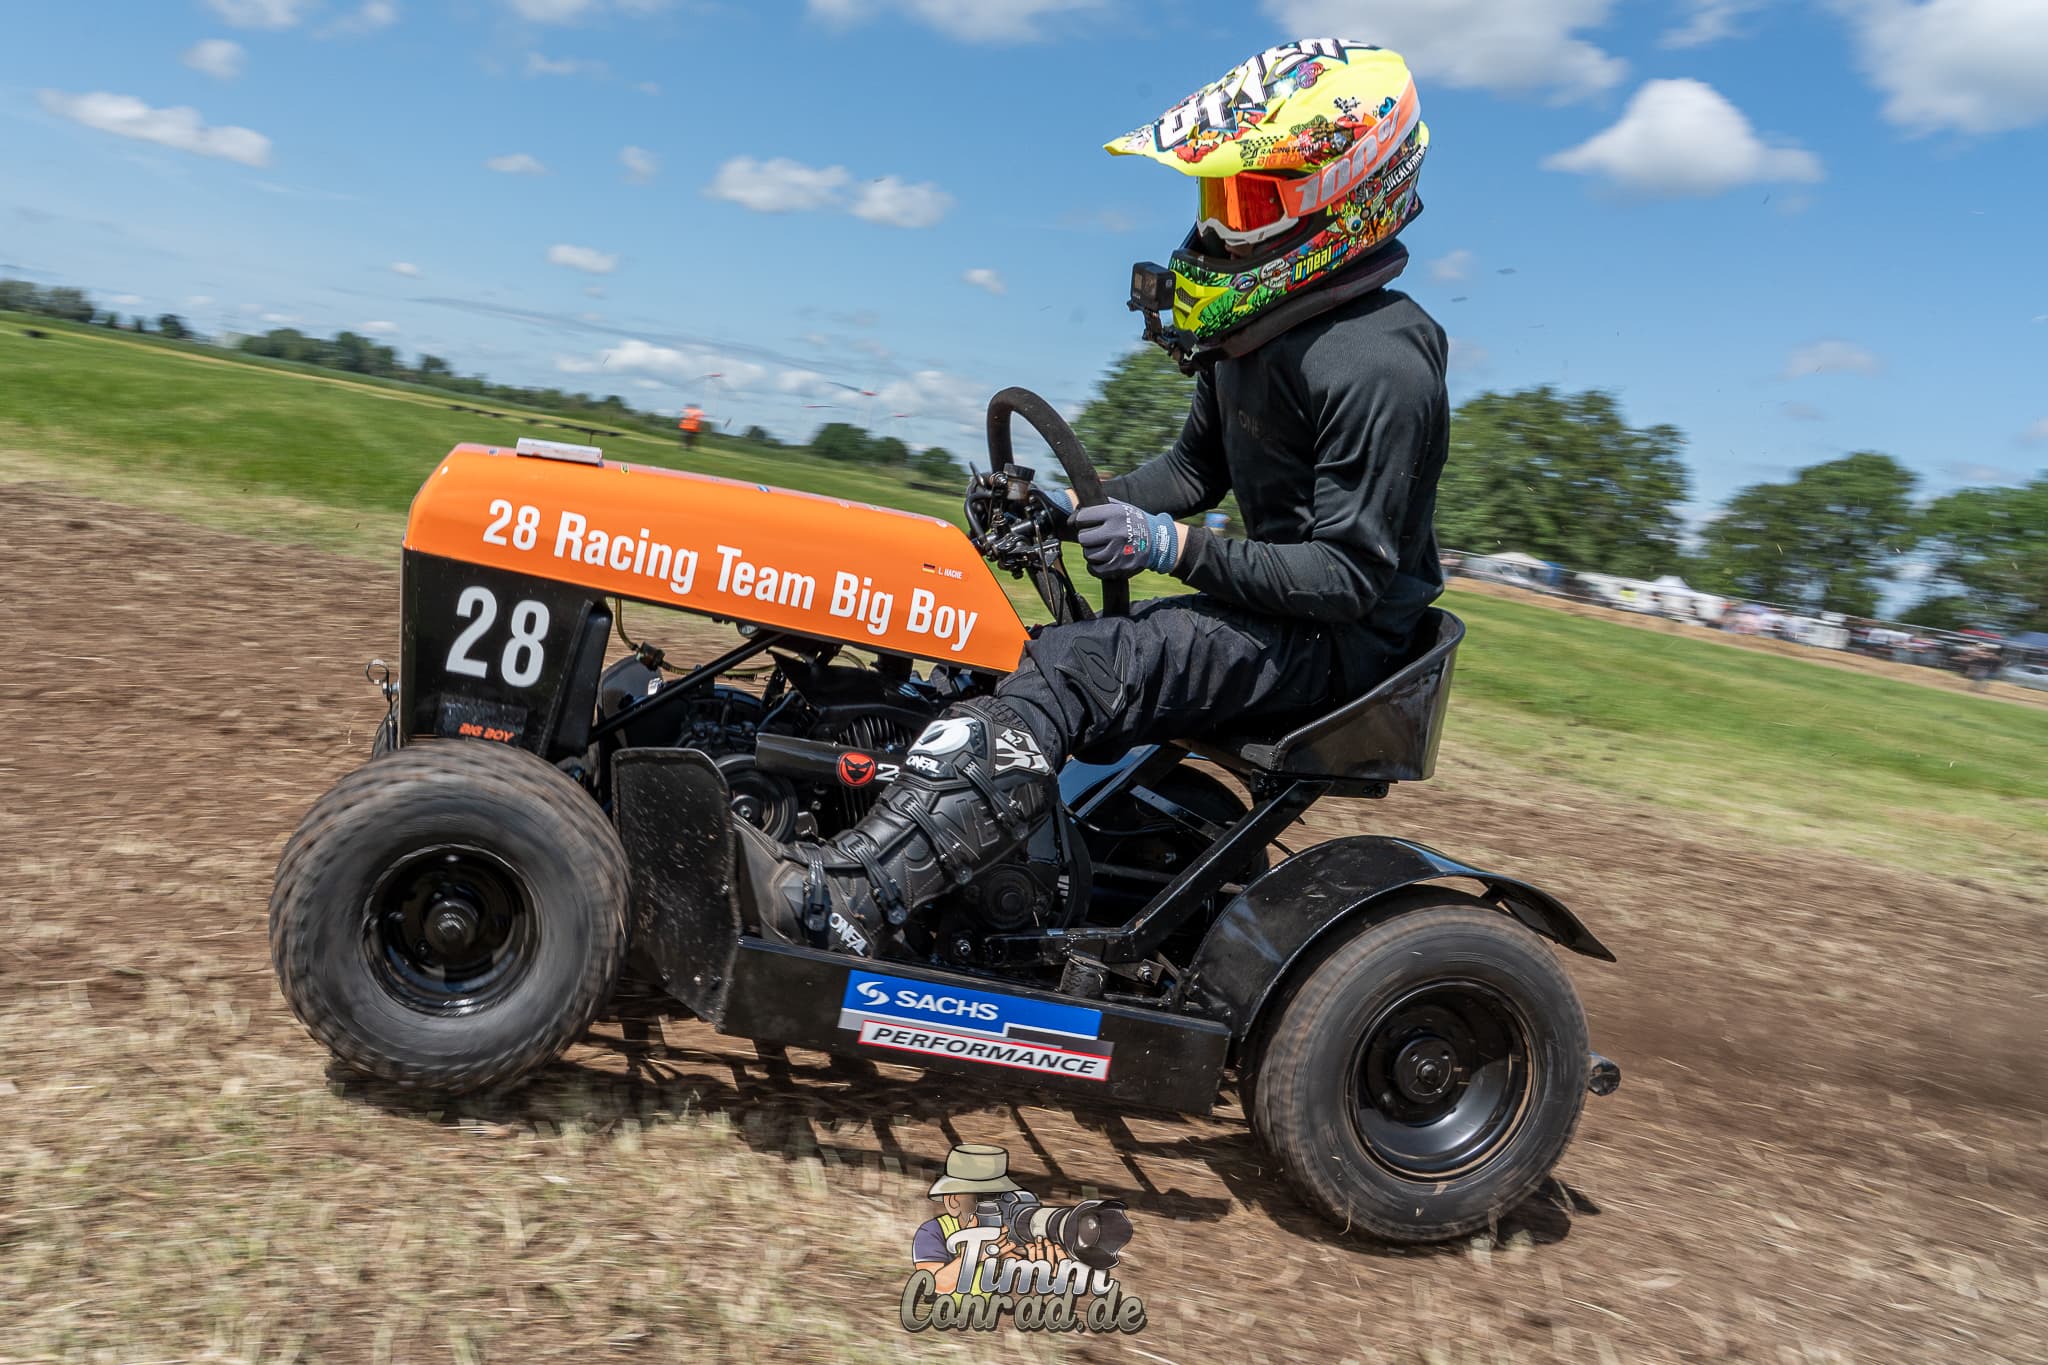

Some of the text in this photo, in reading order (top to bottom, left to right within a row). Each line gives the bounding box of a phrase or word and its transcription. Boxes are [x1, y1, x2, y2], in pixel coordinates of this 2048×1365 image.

[482, 499, 979, 652] 28 Racing Team Big Boy
[446, 586, 550, 688] 28
[459, 722, 516, 743] BIG BOY
[894, 989, 1000, 1021] SACHS
[871, 1027, 1099, 1075] PERFORMANCE
